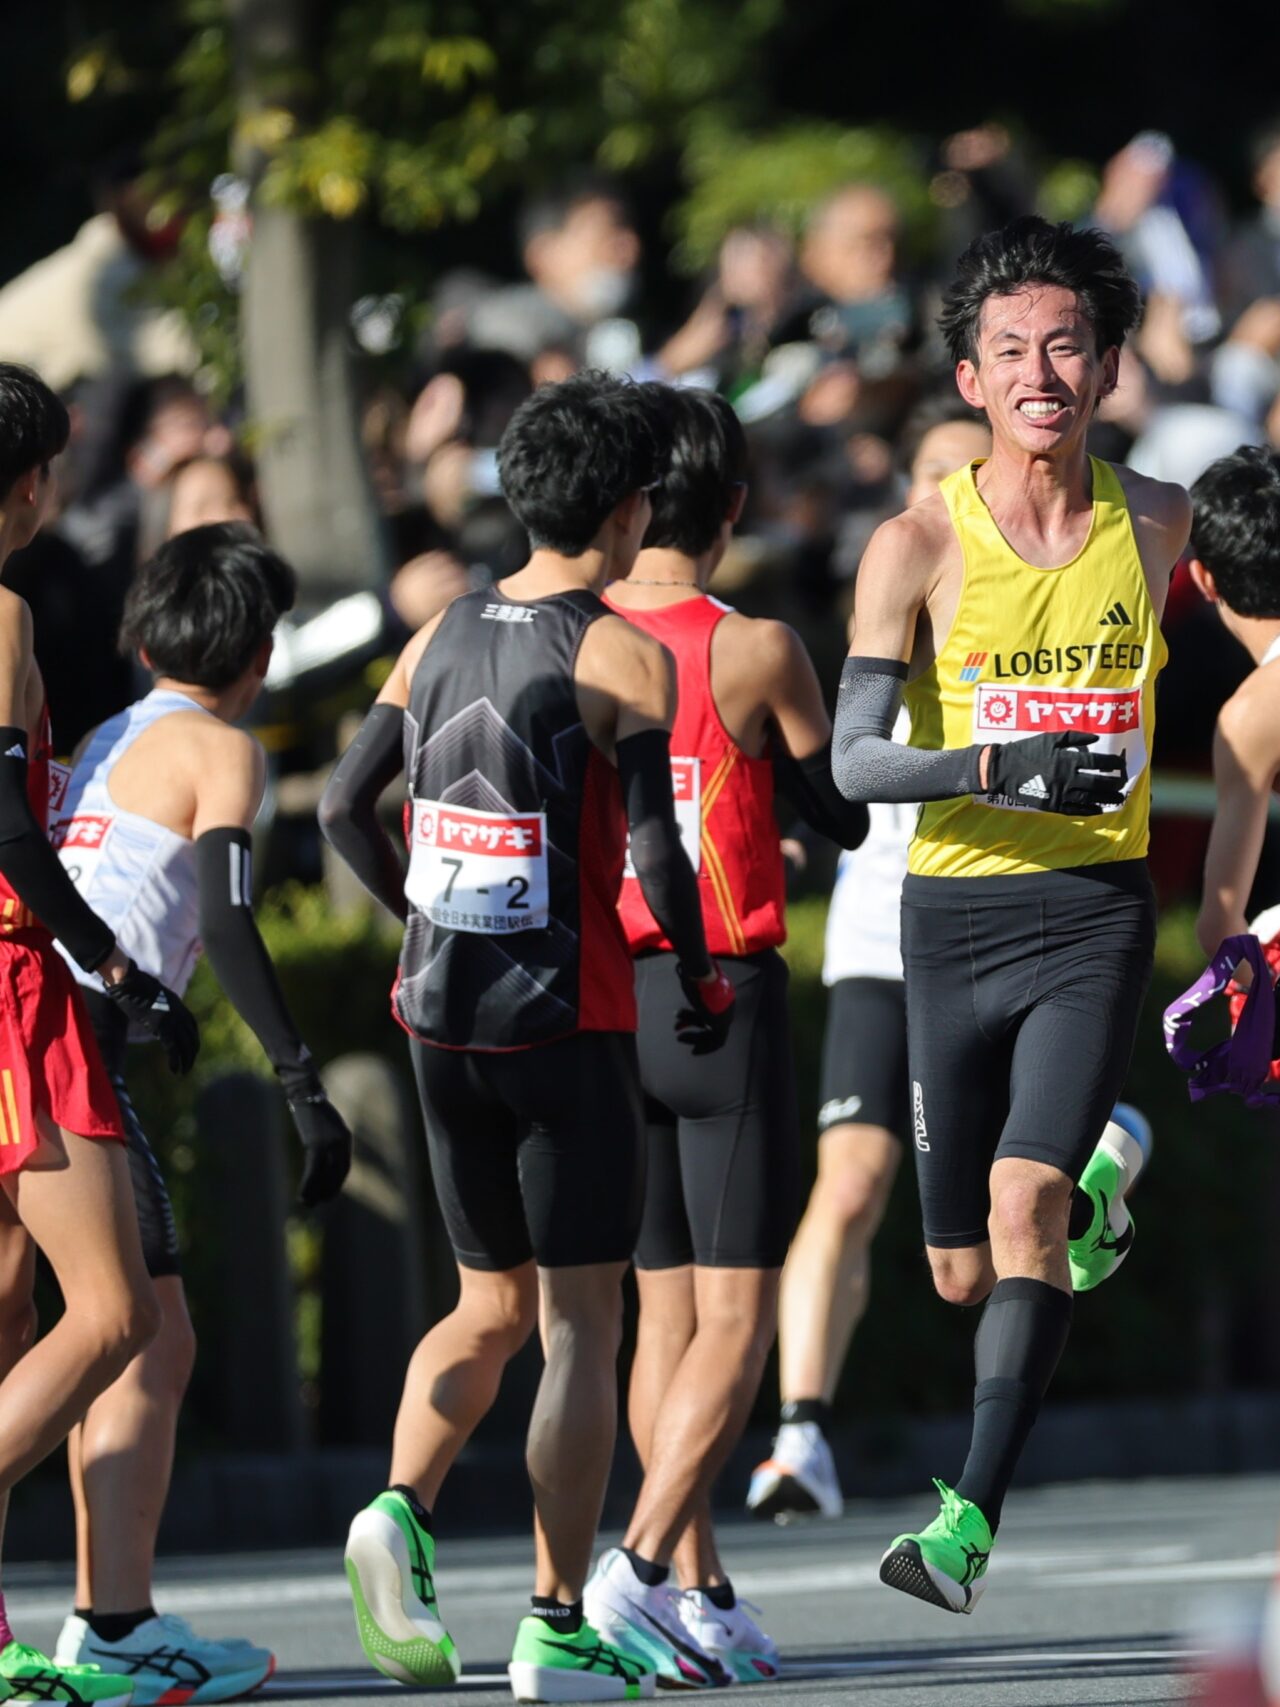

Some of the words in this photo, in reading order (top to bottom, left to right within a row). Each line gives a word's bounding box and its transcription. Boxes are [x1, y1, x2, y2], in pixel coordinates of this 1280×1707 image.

[994, 643, 1144, 678] LOGISTEED
[1024, 699, 1136, 725] ヤマザキ
[441, 818, 533, 849] ヤマザキ
